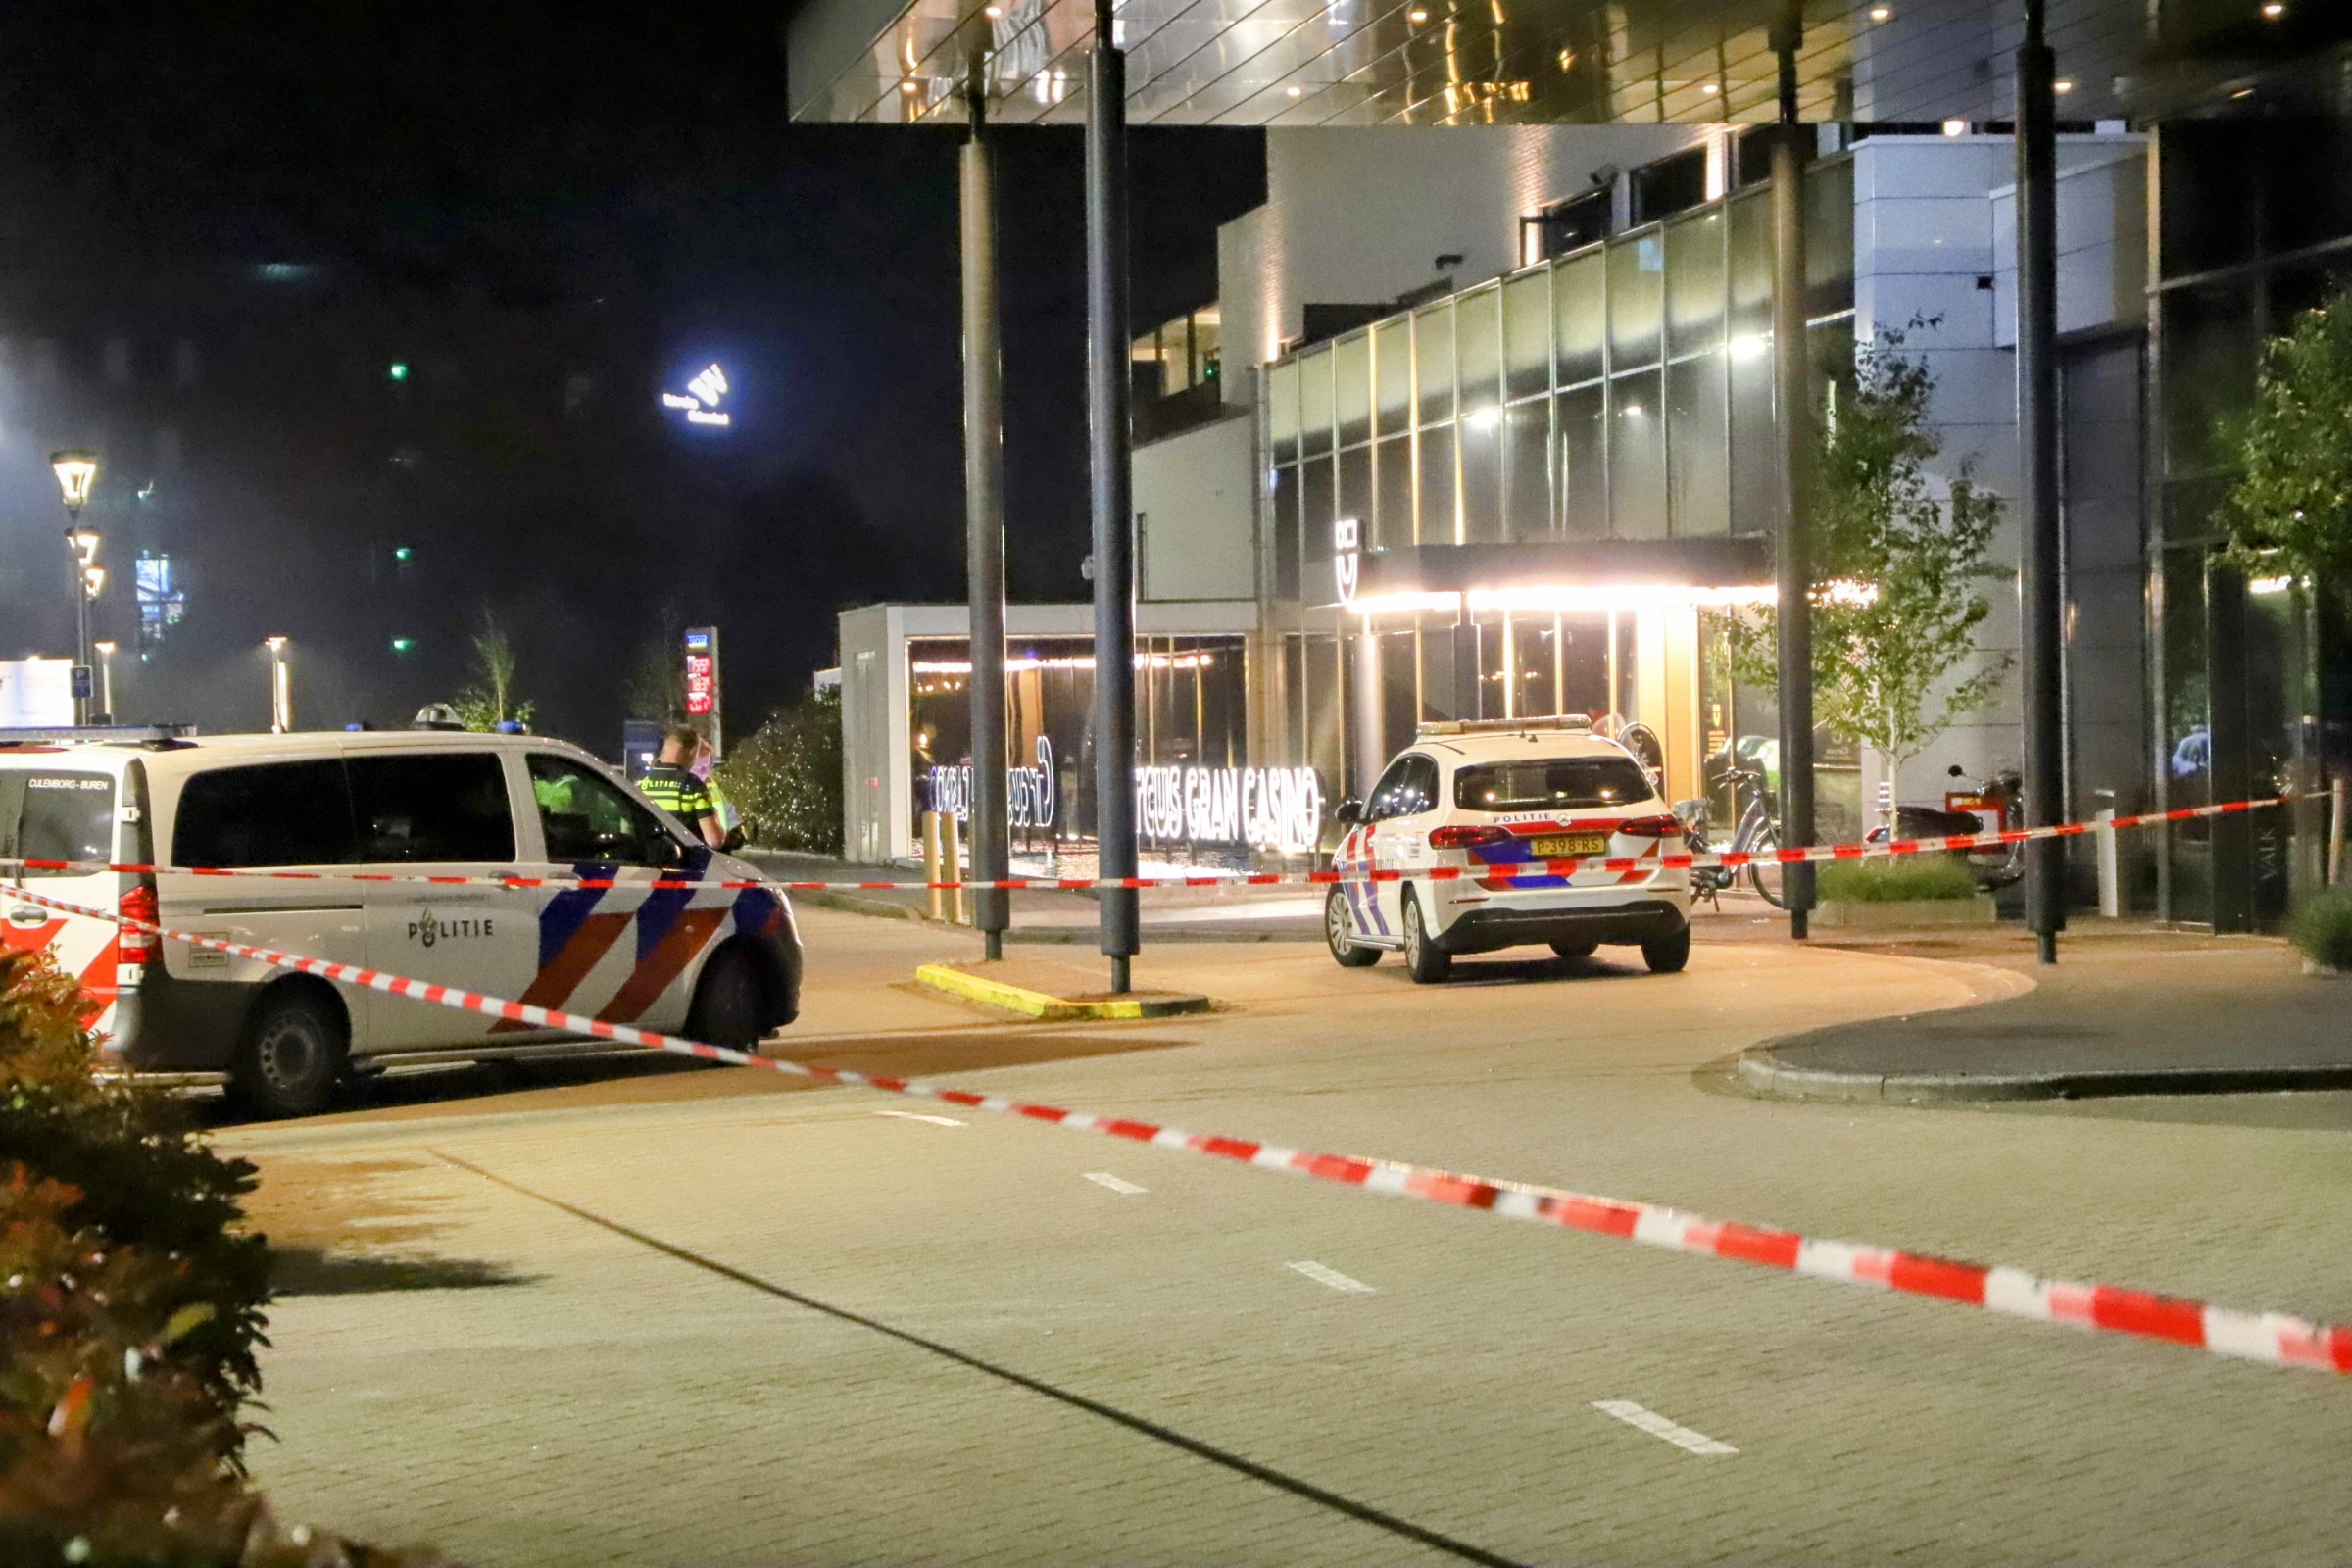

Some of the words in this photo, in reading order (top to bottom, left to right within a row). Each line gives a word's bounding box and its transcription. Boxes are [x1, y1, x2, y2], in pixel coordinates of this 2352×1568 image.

[28, 778, 75, 789] CULEMBORG
[80, 780, 108, 790] BUREN
[1185, 767, 1238, 840] GRAN
[1243, 767, 1319, 846] CASINO
[1494, 812, 1551, 823] POLITIE
[1537, 837, 1600, 854] P-398-RS
[2258, 827, 2276, 880] VALK
[408, 911, 493, 947] POLITIE
